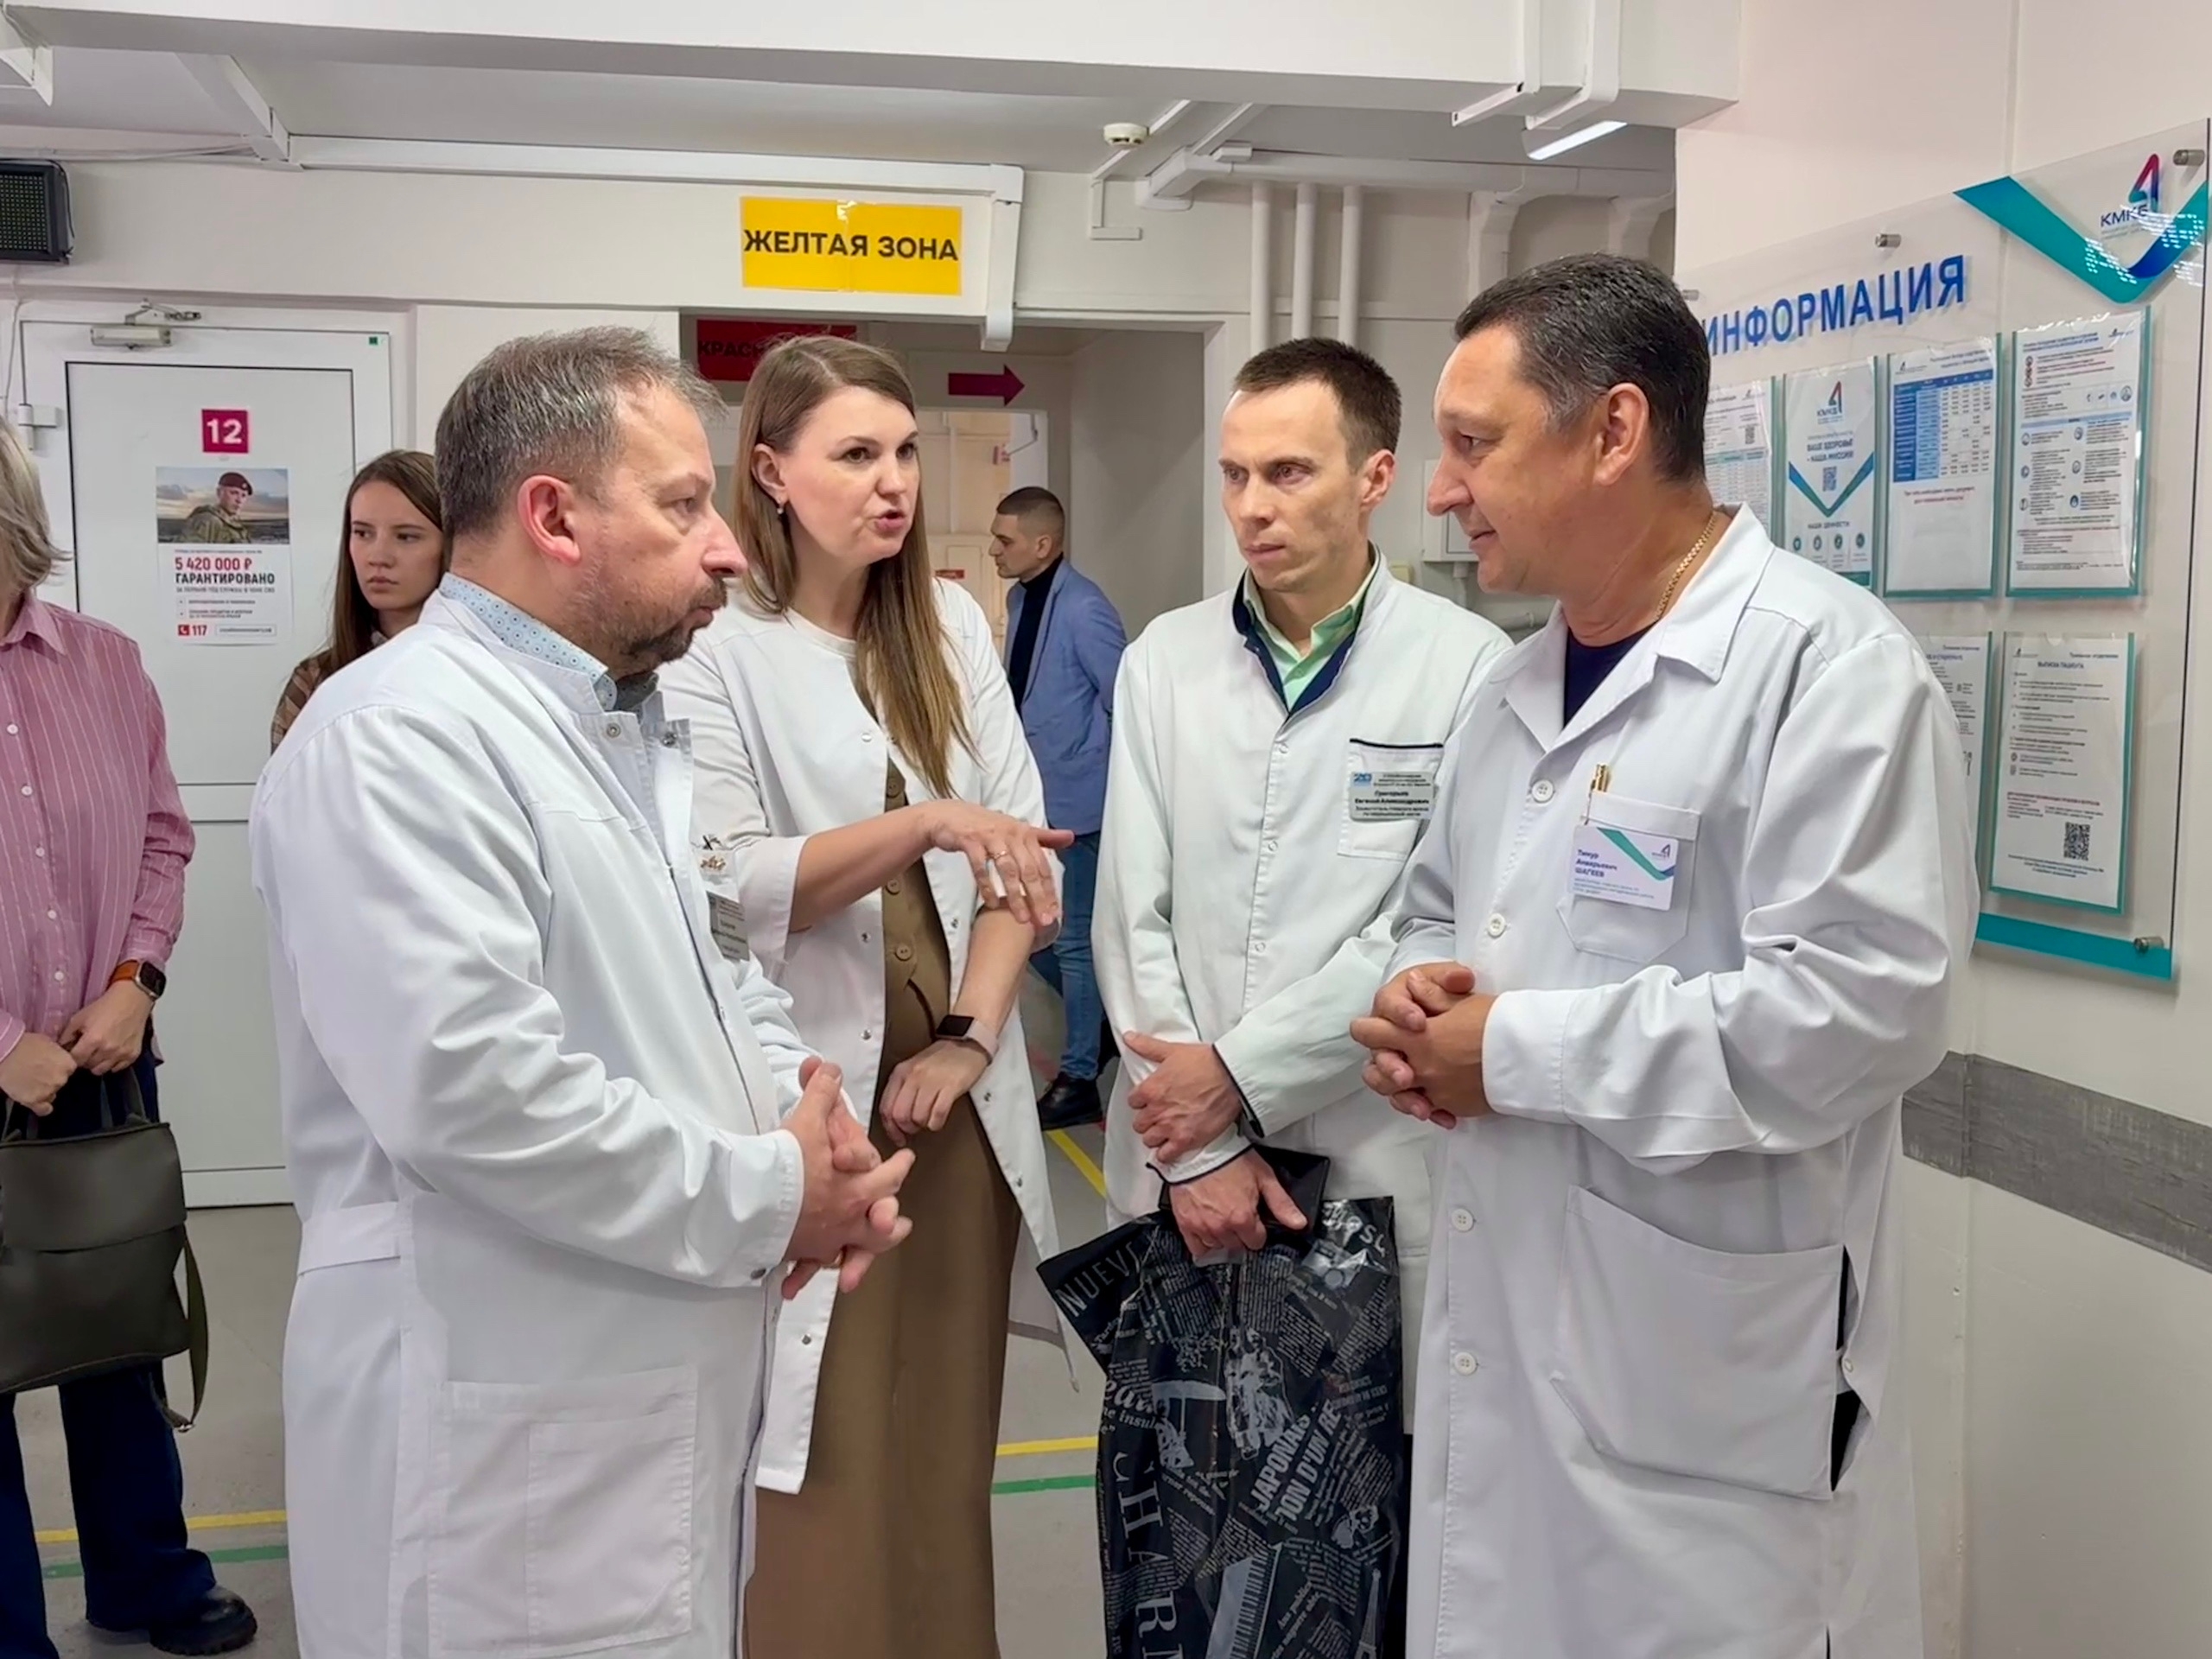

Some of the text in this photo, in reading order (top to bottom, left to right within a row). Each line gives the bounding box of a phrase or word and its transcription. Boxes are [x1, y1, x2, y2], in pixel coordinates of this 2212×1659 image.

[744, 230, 958, 261] ЖЕЛТАЯ ЗОНА
[1702, 255, 1963, 356] ИНФОРМАЦИЯ
[207, 418, 243, 445] 12
[175, 557, 183, 570] 5
[187, 557, 211, 570] 420
[215, 557, 240, 570] 000
[175, 573, 275, 584] ГАРАНТИРОВАНО
[192, 625, 207, 636] 117
[1250, 1414, 1310, 1511] JAPONAIS
[1296, 1429, 1330, 1483] D'UN
